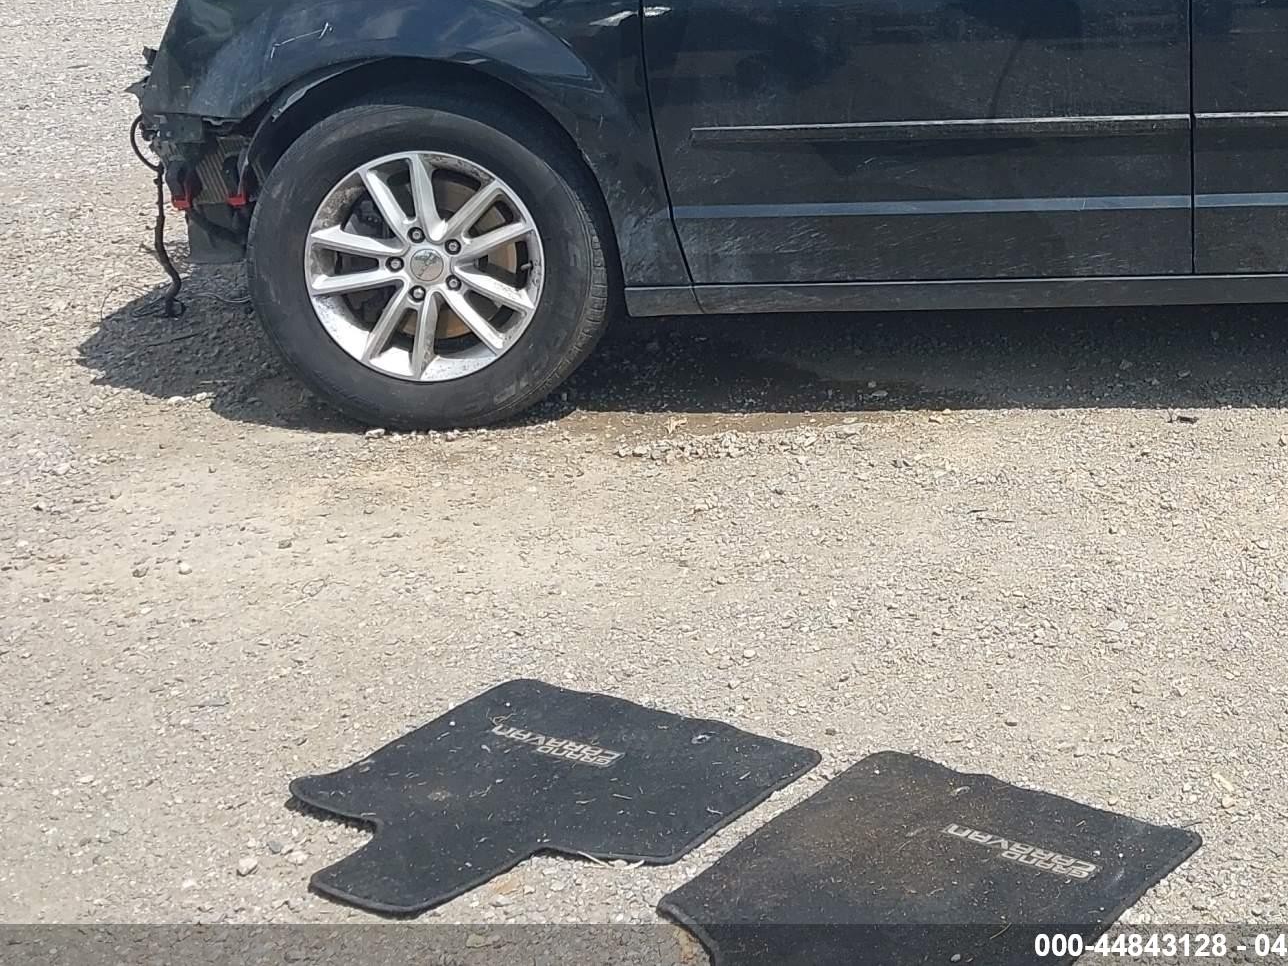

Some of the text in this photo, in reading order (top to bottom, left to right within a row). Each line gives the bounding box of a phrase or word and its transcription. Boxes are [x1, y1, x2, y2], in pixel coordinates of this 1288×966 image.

[492, 724, 625, 761] CARAVAN
[536, 745, 613, 767] GRAND
[944, 823, 1097, 872] CARAVAN
[1001, 850, 1090, 878] GRAND
